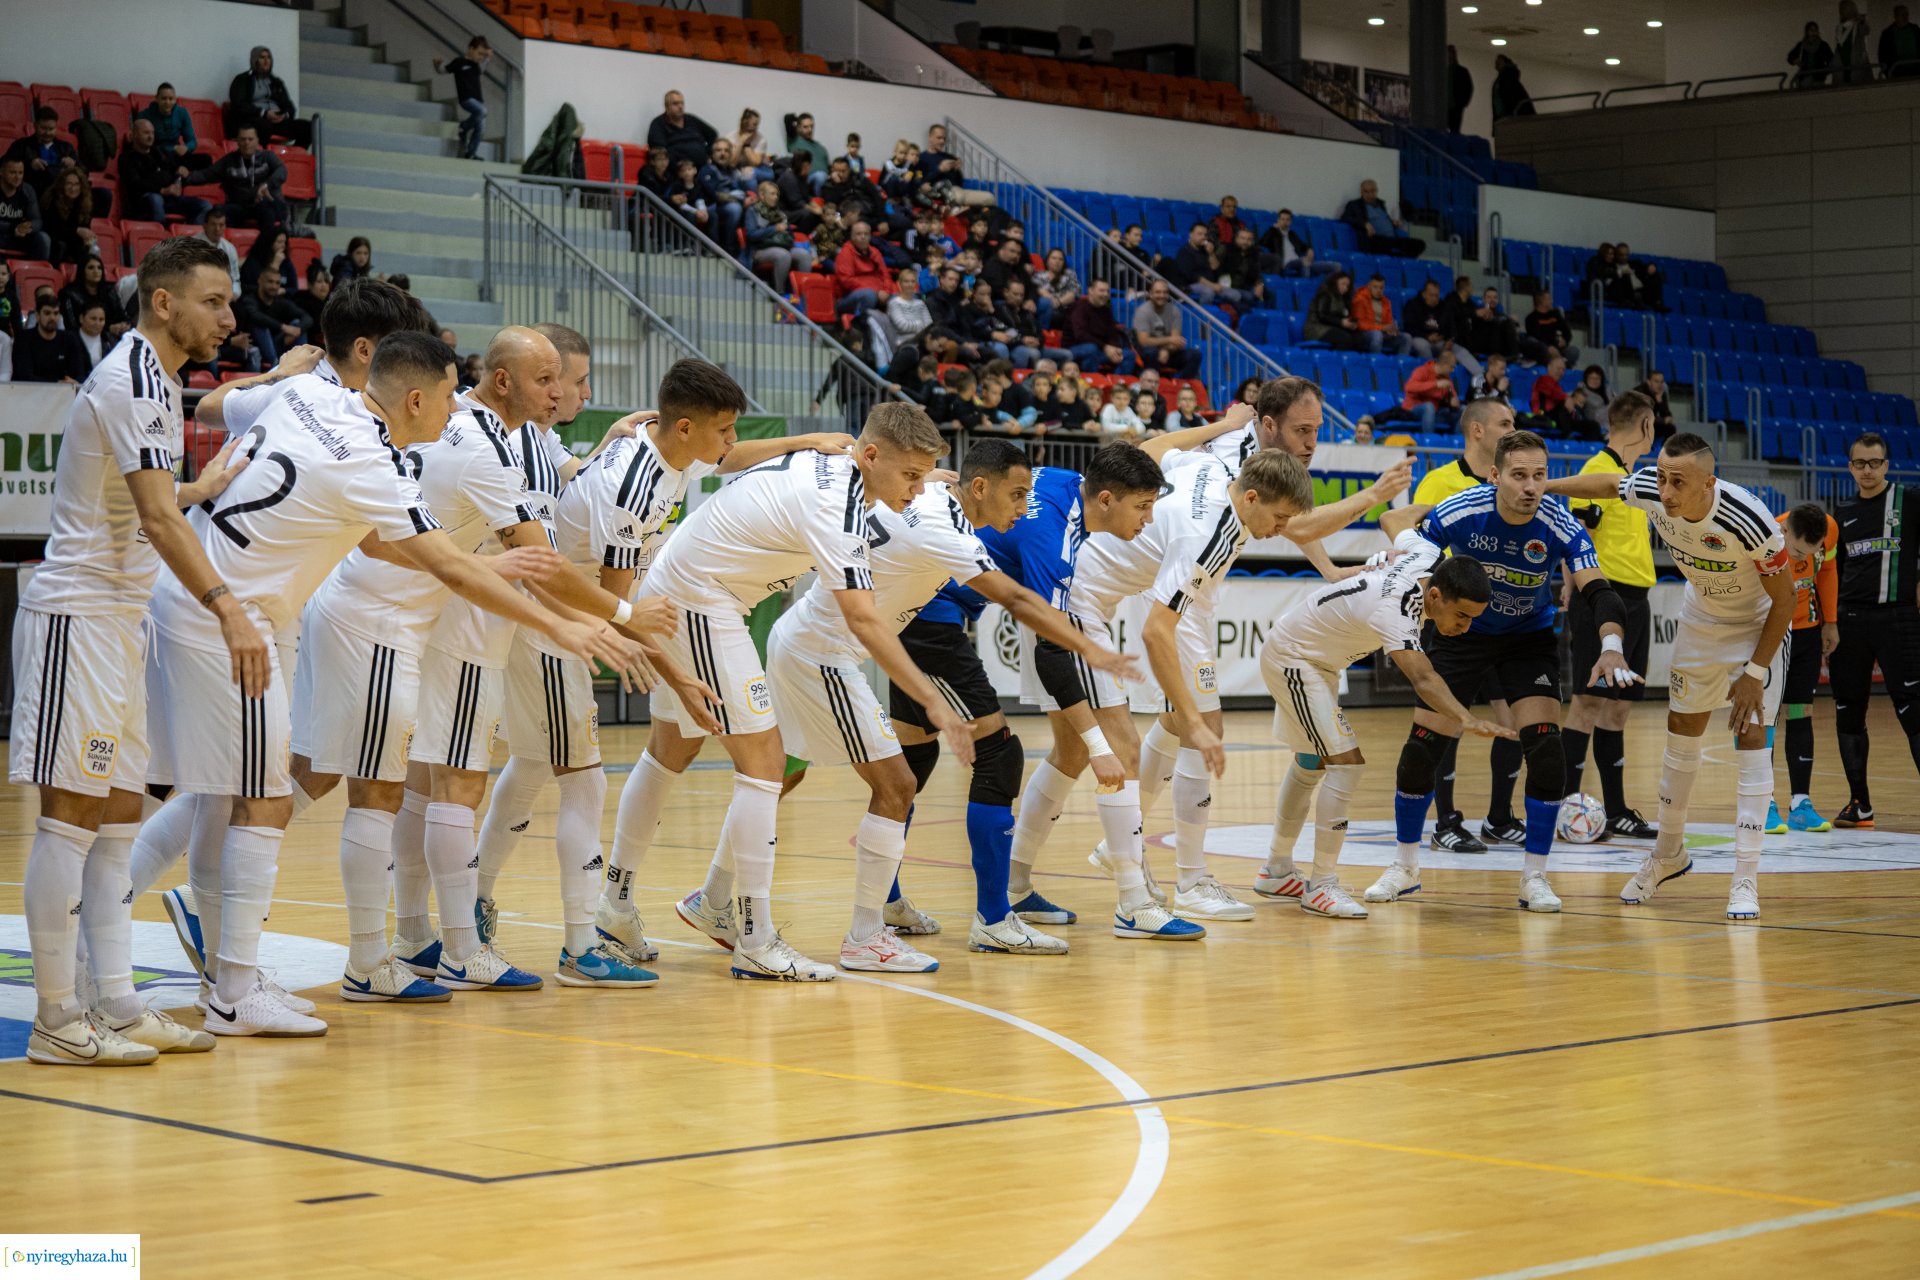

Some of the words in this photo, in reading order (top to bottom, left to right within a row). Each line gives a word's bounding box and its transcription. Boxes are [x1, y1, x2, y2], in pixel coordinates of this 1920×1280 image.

[1467, 532, 1499, 553] 383
[90, 739, 115, 755] 99.4
[92, 760, 107, 773] FM
